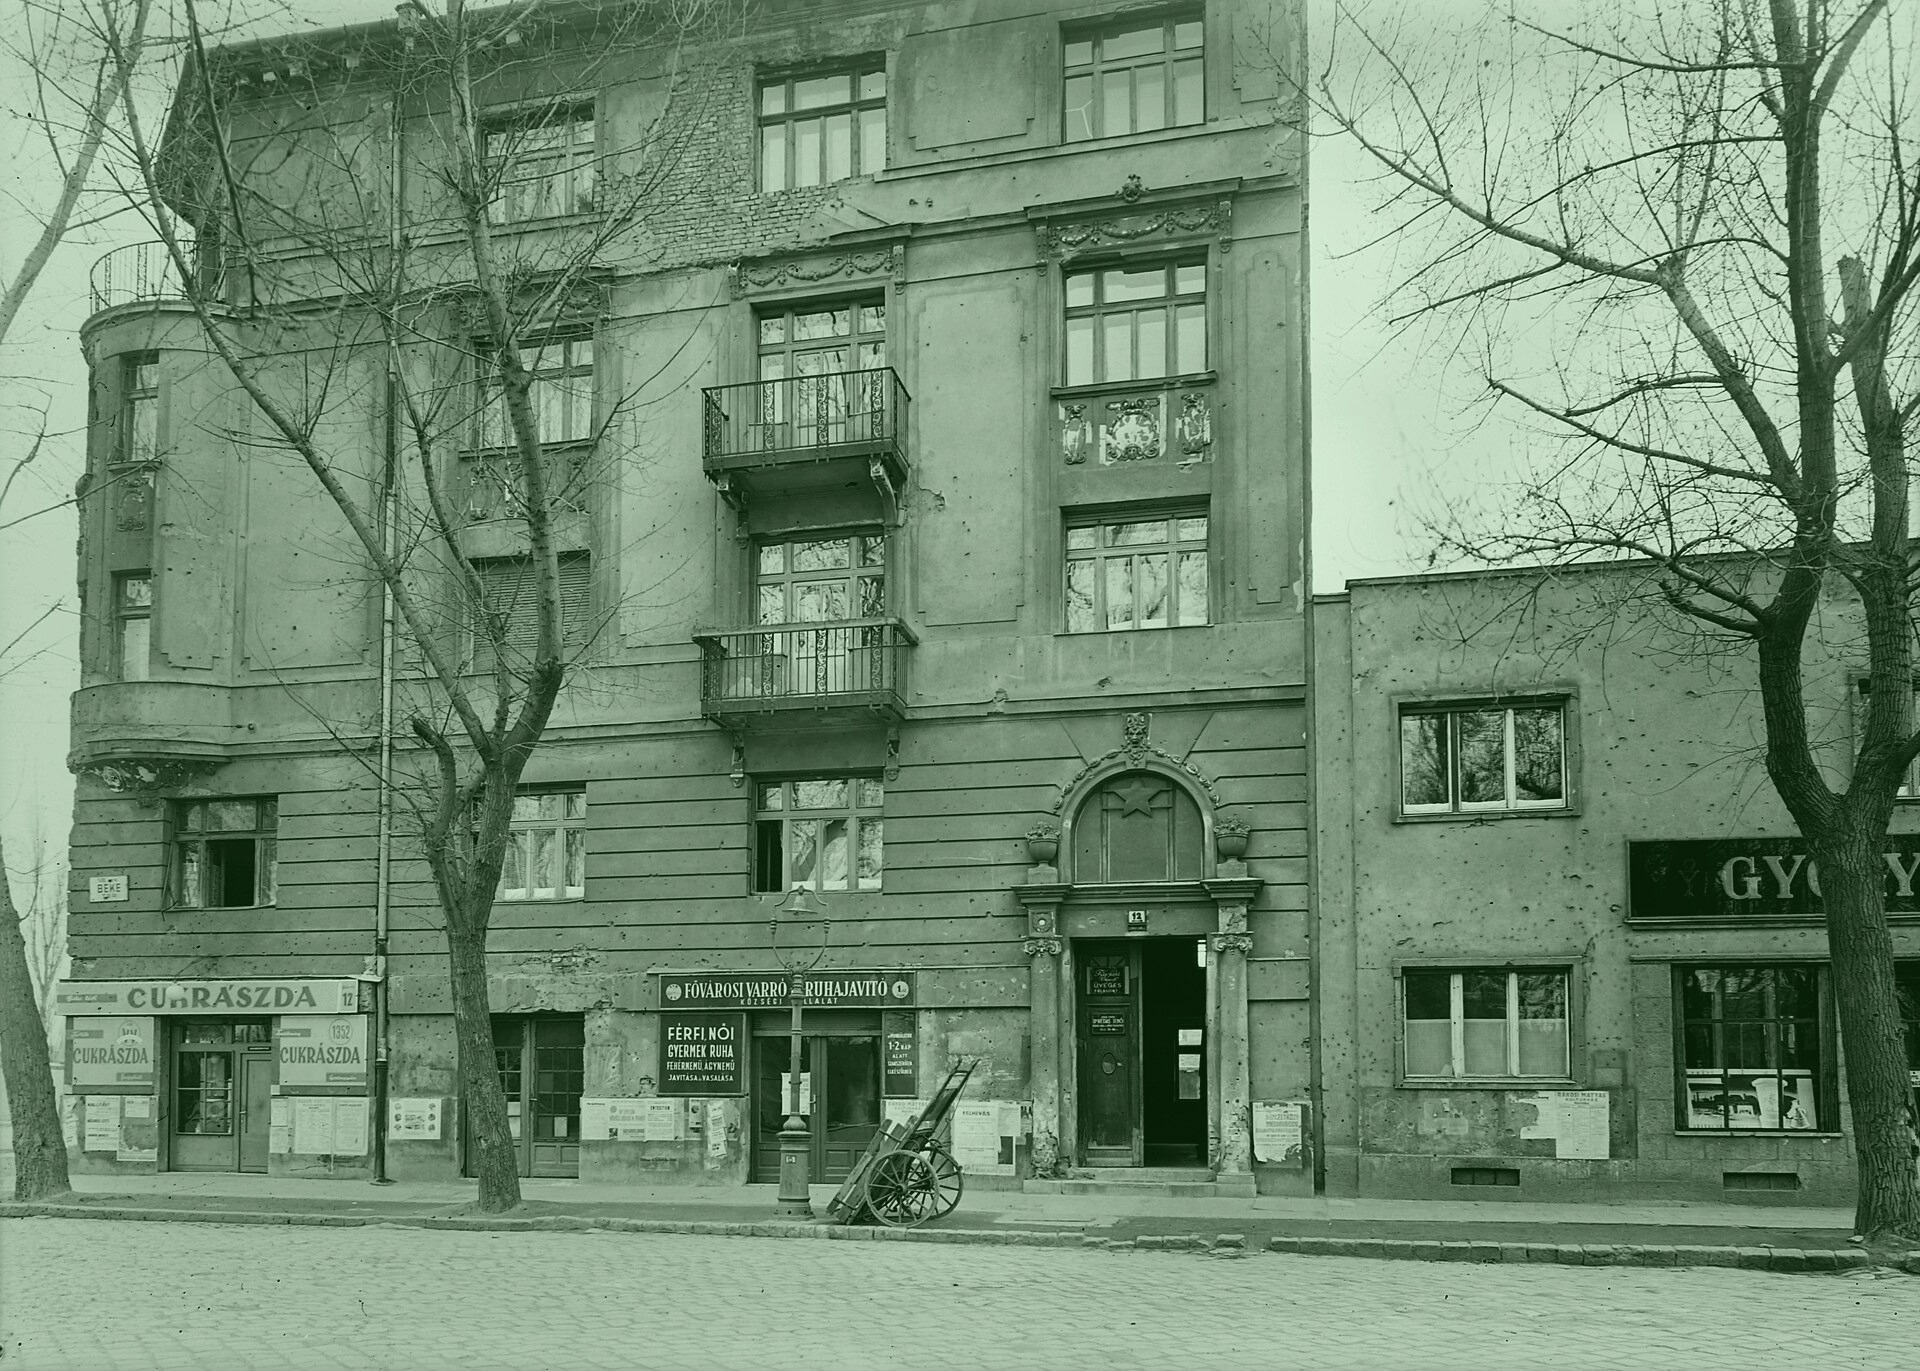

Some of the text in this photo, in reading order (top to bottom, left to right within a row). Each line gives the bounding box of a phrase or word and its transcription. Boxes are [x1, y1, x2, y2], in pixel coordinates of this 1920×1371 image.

[1721, 853, 1920, 899] GYY
[1132, 912, 1142, 920] 12
[684, 980, 744, 998] FŐVÁROSI
[746, 978, 788, 998] VARRÓ
[805, 978, 888, 997] RUHAJAVITÓ
[342, 993, 353, 1006] 12
[740, 998, 783, 1006] KÖZSÉGI
[331, 1025, 350, 1040] 1352
[708, 1023, 734, 1041] NŐI
[73, 1045, 149, 1064] CUKRÁSZDA
[280, 1043, 361, 1064] CUKRÁSZDA
[667, 1044, 734, 1058] GYERMEK RUHA
[702, 1073, 734, 1082] VASALÁSA
